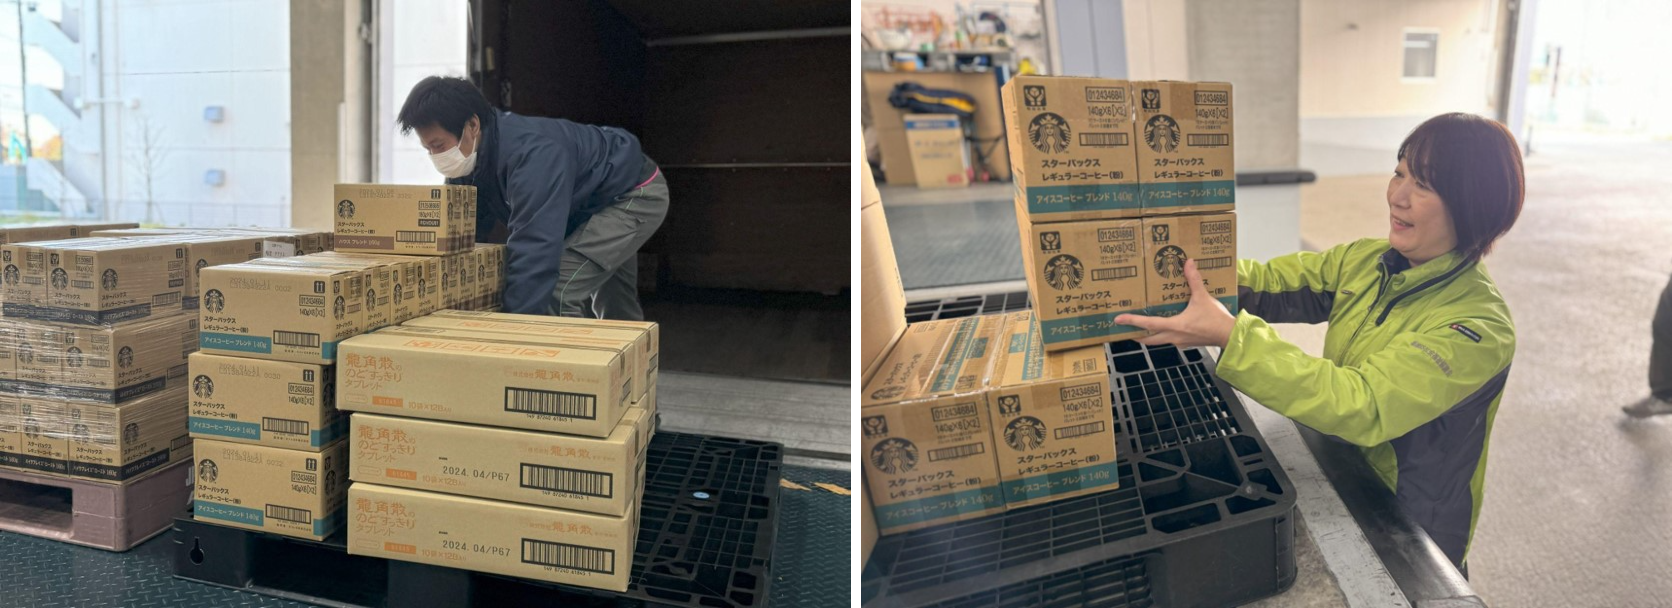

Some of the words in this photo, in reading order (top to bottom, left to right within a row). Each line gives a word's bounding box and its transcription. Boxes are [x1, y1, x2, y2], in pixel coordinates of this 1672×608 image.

[1088, 89, 1123, 100] 012434684
[1195, 93, 1227, 104] 012434684
[1041, 159, 1101, 168] スターバックス
[1154, 158, 1205, 166] スターバックス
[1042, 171, 1124, 181] レギュラーコーヒー(粉)
[1154, 169, 1224, 179] レギュラーコーヒー(粉)
[1036, 194, 1083, 204] アイスコーヒー
[1085, 193, 1110, 202] ブレンド
[1113, 191, 1133, 202] 140g
[1148, 191, 1188, 200] アイスコーヒー
[1190, 189, 1211, 197] ブレンド
[1213, 188, 1231, 197] 140g
[1162, 279, 1209, 291] スターバス
[1056, 290, 1112, 303] スターバックス
[1162, 287, 1227, 301] レギュラーー(粉)
[1056, 299, 1132, 315] レギュラーコーヒー(粉)
[204, 316, 237, 324] スターバックス
[1050, 324, 1095, 335] アイスコーヒー
[204, 336, 234, 346] アイスコーヒー
[345, 368, 402, 383] のどすっきり
[344, 379, 382, 391] タブレット
[1062, 385, 1100, 399] 012434684
[193, 401, 226, 410] スターバックス
[934, 405, 975, 419] 012434684
[192, 422, 224, 431] アイスコーヒー
[224, 425, 241, 433] ブレンド
[242, 427, 256, 436] 140g
[76, 447, 103, 455] スターバックス
[358, 439, 416, 455] のどすっきり
[357, 451, 397, 463] タブレット
[1017, 448, 1077, 465] スターバックス
[1018, 454, 1100, 476] レギュラーコーヒー(粉)
[888, 470, 955, 488] スターバックス
[1013, 481, 1060, 495] アイスコーヒー
[1061, 474, 1087, 486] ブレンド
[1089, 470, 1110, 481] 140g
[198, 484, 230, 495] スターバックス
[889, 477, 982, 499] レギュラーコーヒー(粉)
[198, 505, 227, 515] アイスコーヒー
[228, 510, 244, 519] ブレンド
[885, 504, 939, 520] アイスコーヒー
[939, 497, 968, 510] ブレンド
[970, 494, 994, 505] 140g
[355, 512, 416, 530] のどすっきり
[355, 523, 396, 537] タブレット
